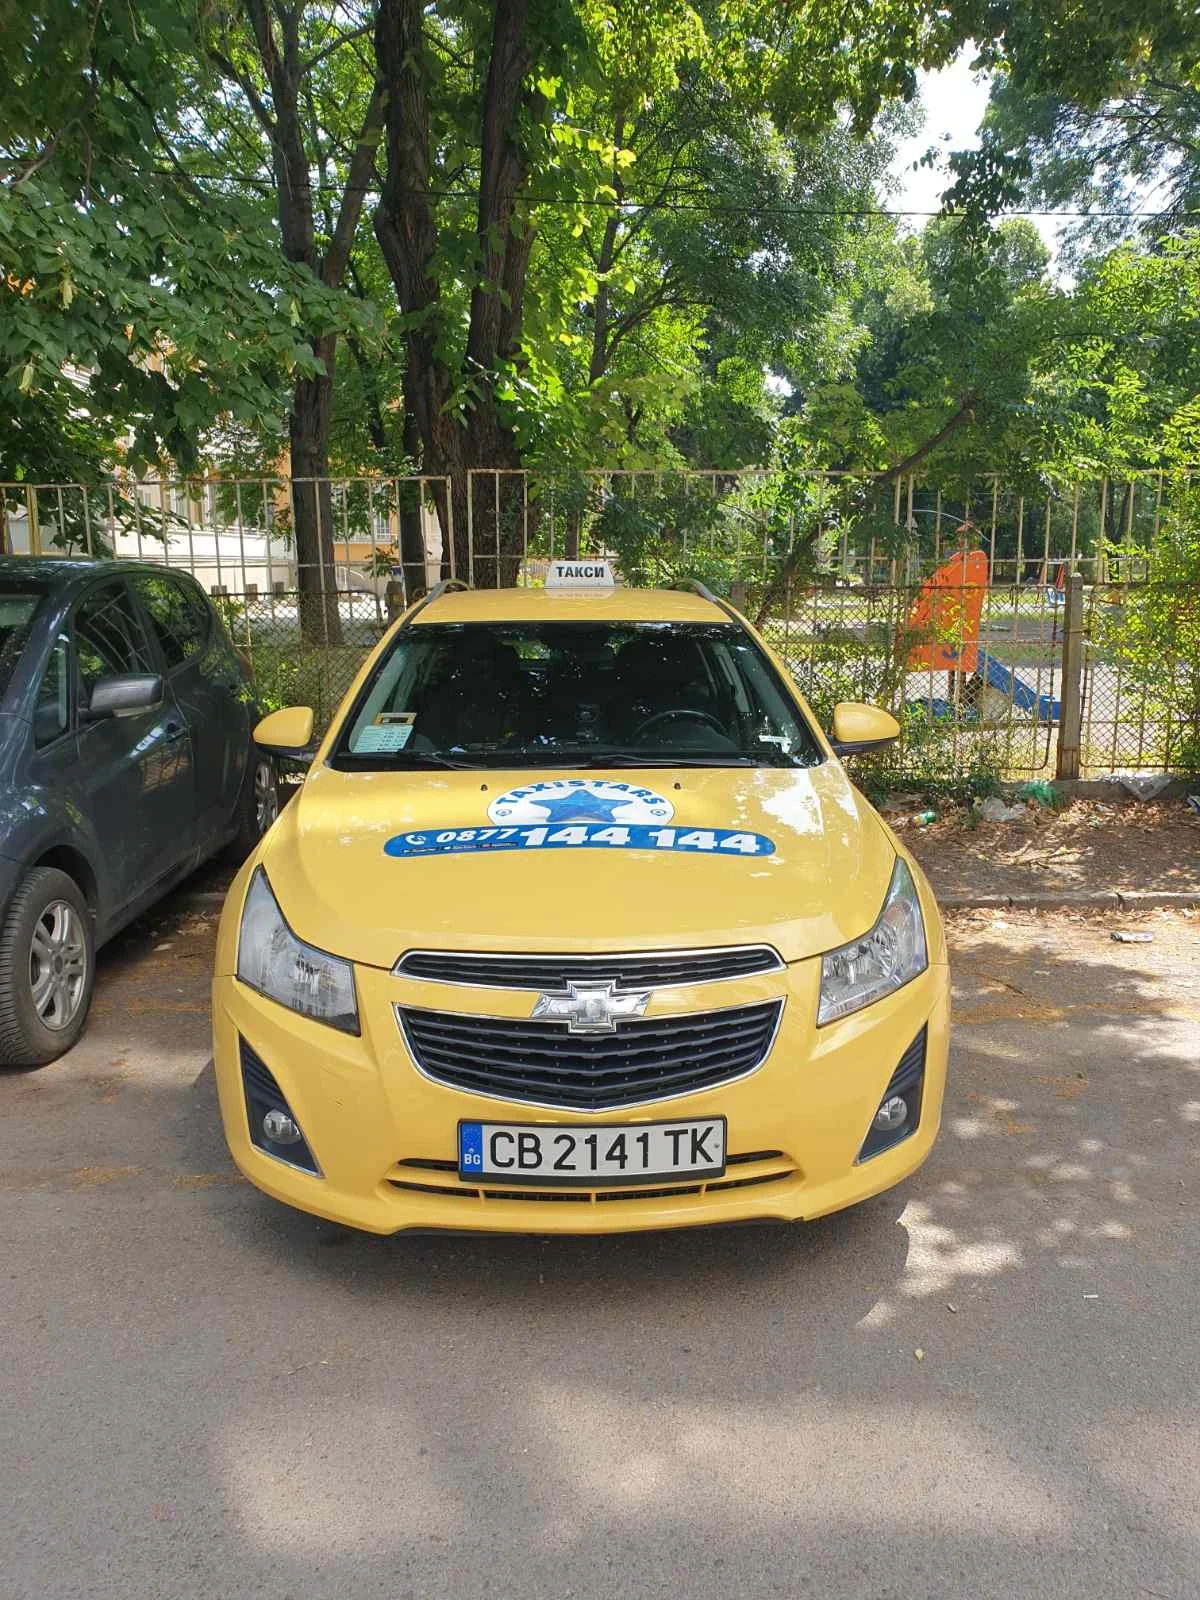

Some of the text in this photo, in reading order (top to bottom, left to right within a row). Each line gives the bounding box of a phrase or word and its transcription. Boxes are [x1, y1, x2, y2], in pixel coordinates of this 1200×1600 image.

[555, 566, 605, 578] ТАКСИ
[495, 780, 665, 805] TAXISTARS
[435, 826, 761, 853] 0877 144 144
[463, 1153, 481, 1166] BG
[489, 1126, 715, 1171] CB 2141 TK
